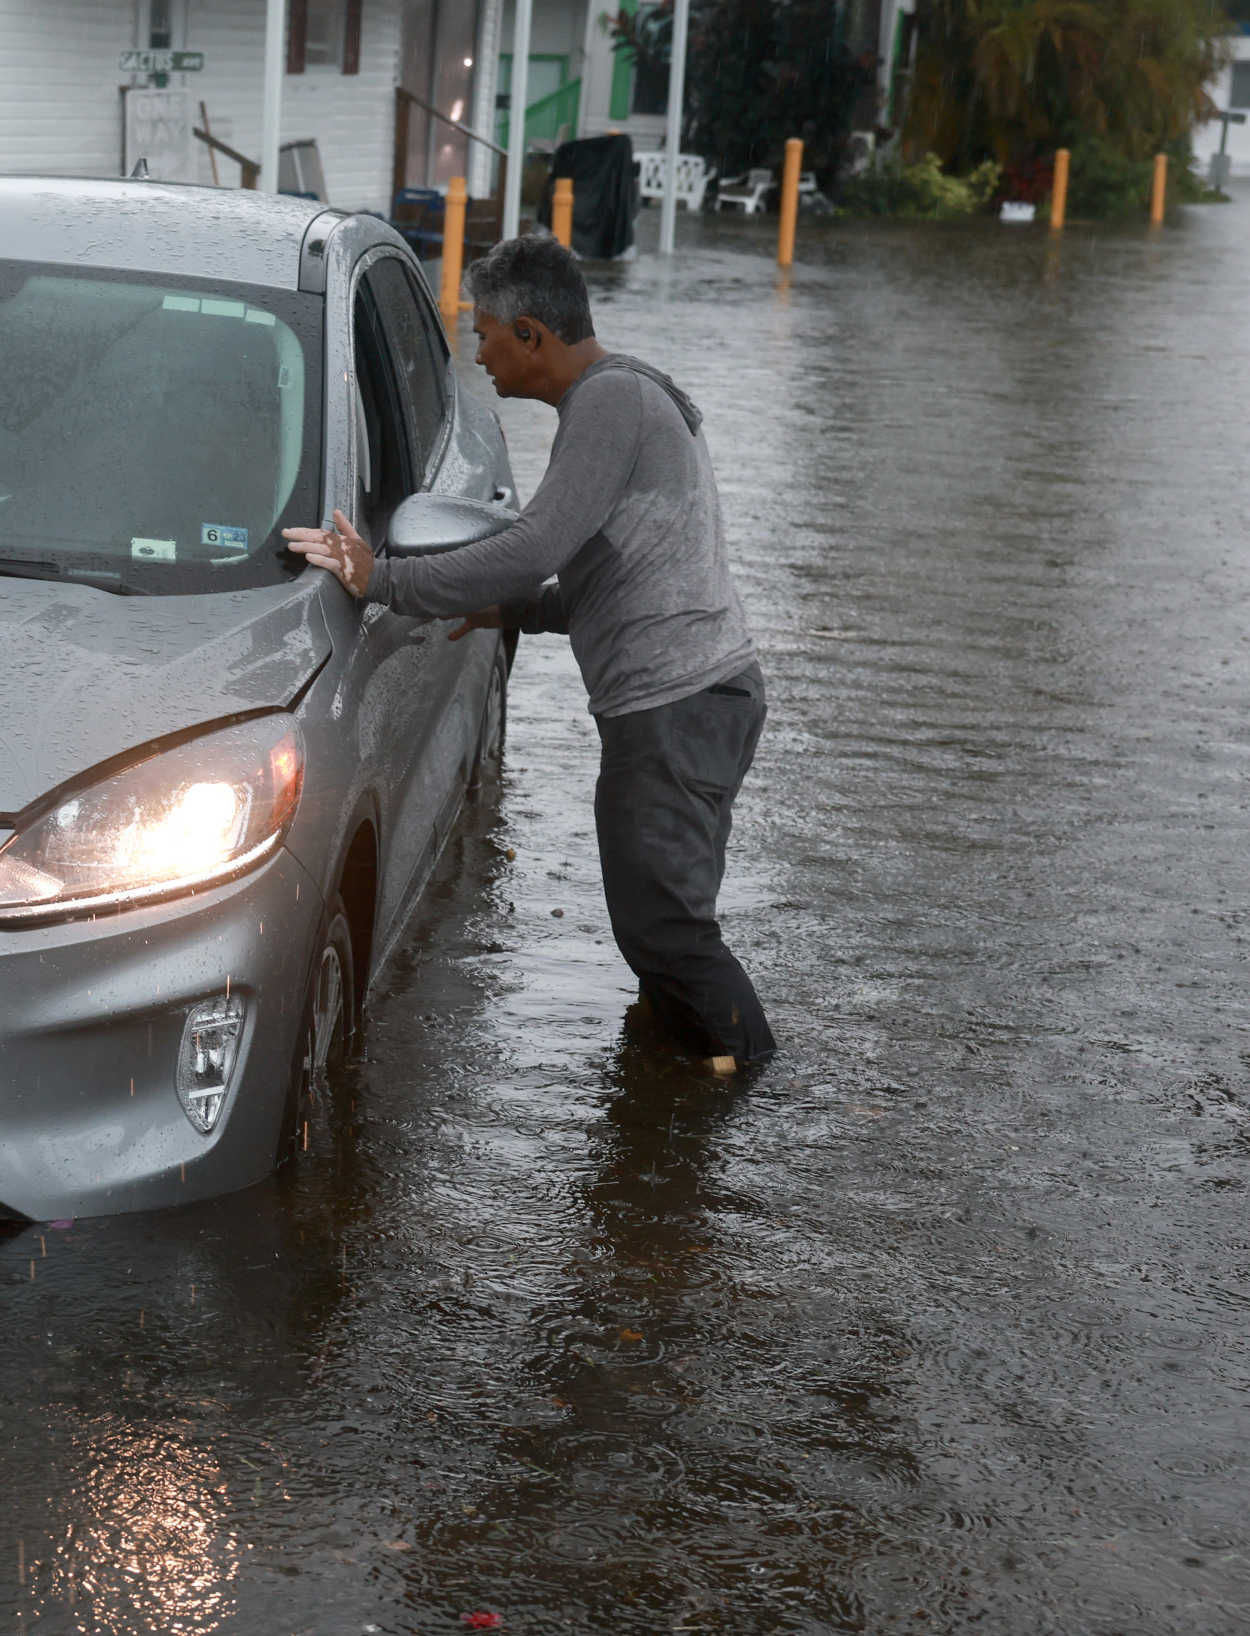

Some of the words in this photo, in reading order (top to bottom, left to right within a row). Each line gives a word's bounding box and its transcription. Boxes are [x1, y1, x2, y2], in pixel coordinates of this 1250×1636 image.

[120, 51, 173, 71] CACTUS
[135, 96, 182, 119] ONE
[134, 121, 185, 144] WAY
[207, 529, 218, 542] 6
[233, 532, 246, 542] 23
